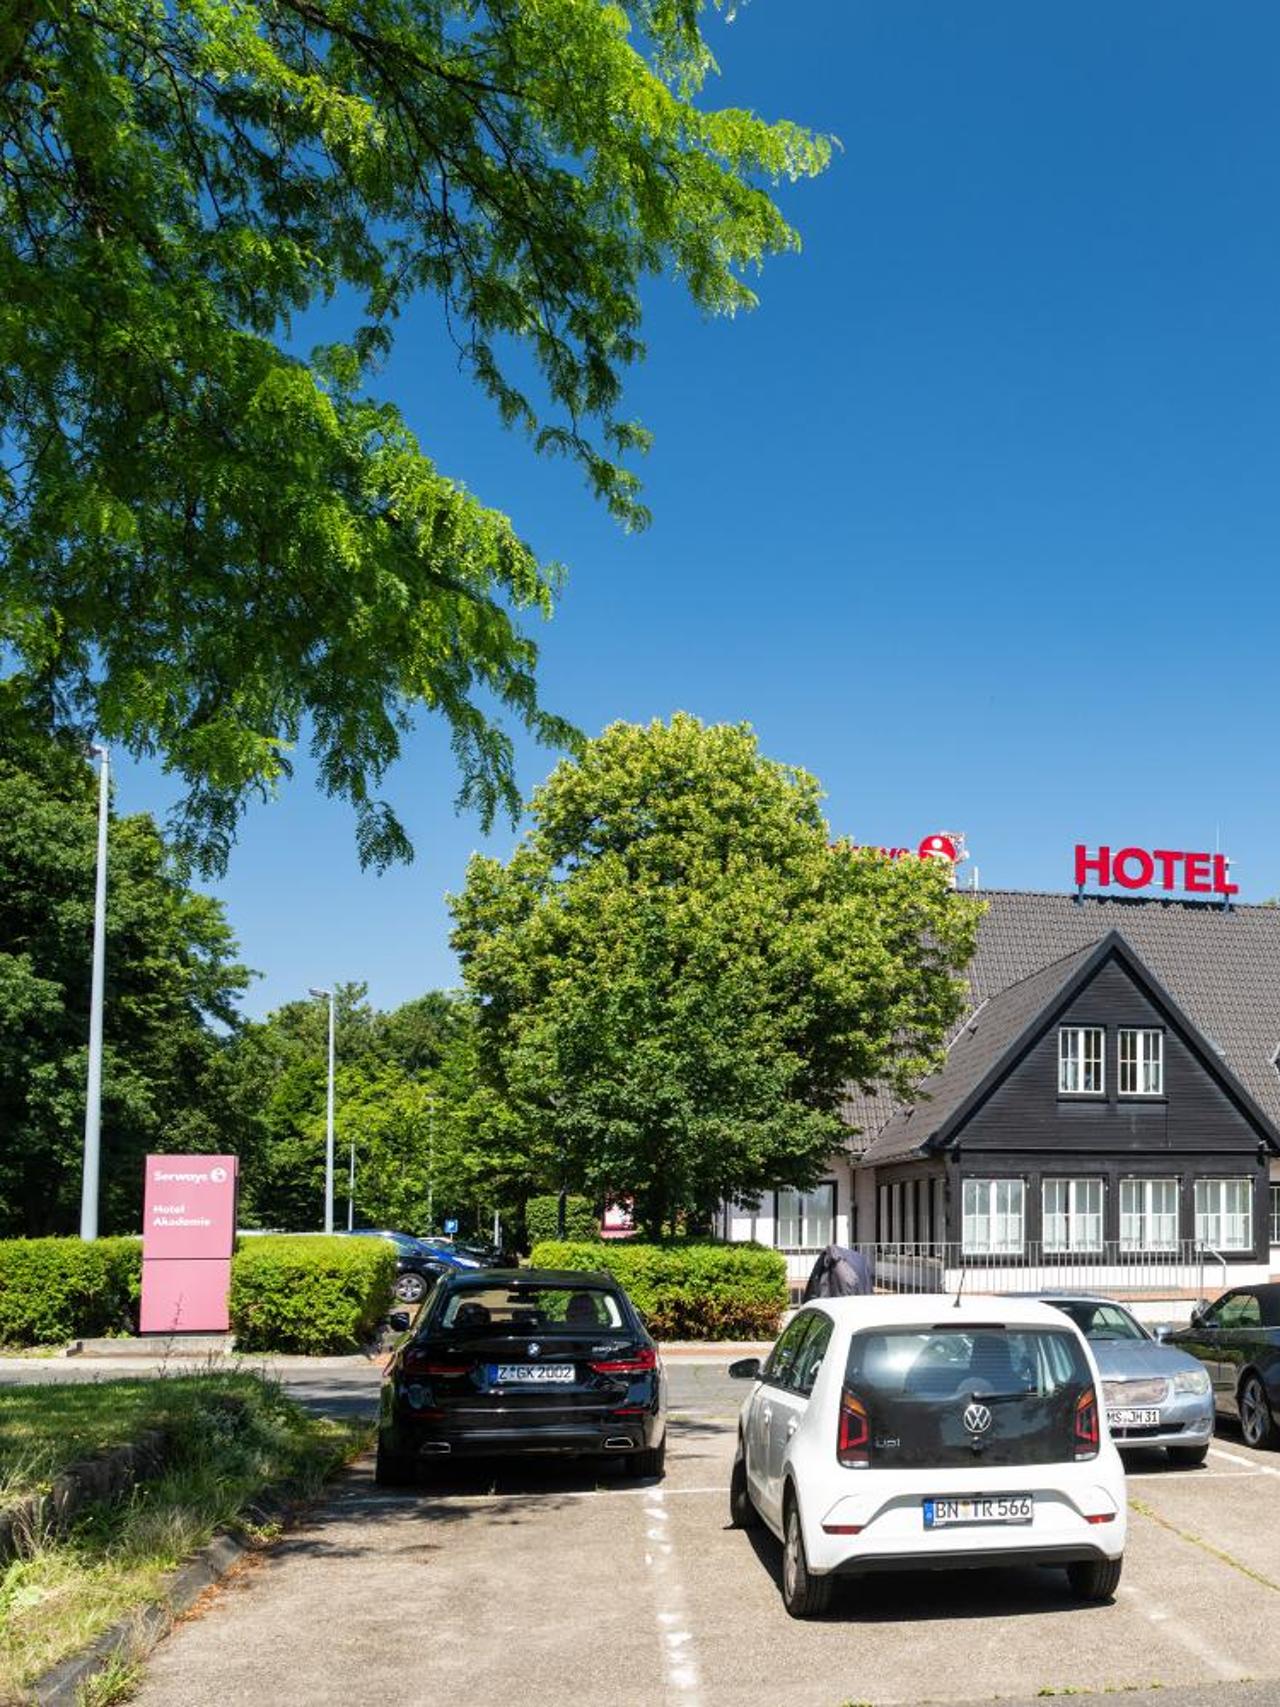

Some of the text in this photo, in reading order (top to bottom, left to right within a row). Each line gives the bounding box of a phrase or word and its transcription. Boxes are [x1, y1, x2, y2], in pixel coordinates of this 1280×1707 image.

[1075, 845, 1239, 894] HOTEL
[153, 1170, 209, 1184] Serways
[153, 1205, 185, 1215] Hotel
[153, 1217, 211, 1227] Akademie
[500, 1364, 572, 1380] Z GK 2002
[1145, 1411, 1157, 1423] 31
[936, 1499, 1030, 1518] BN TR 566
